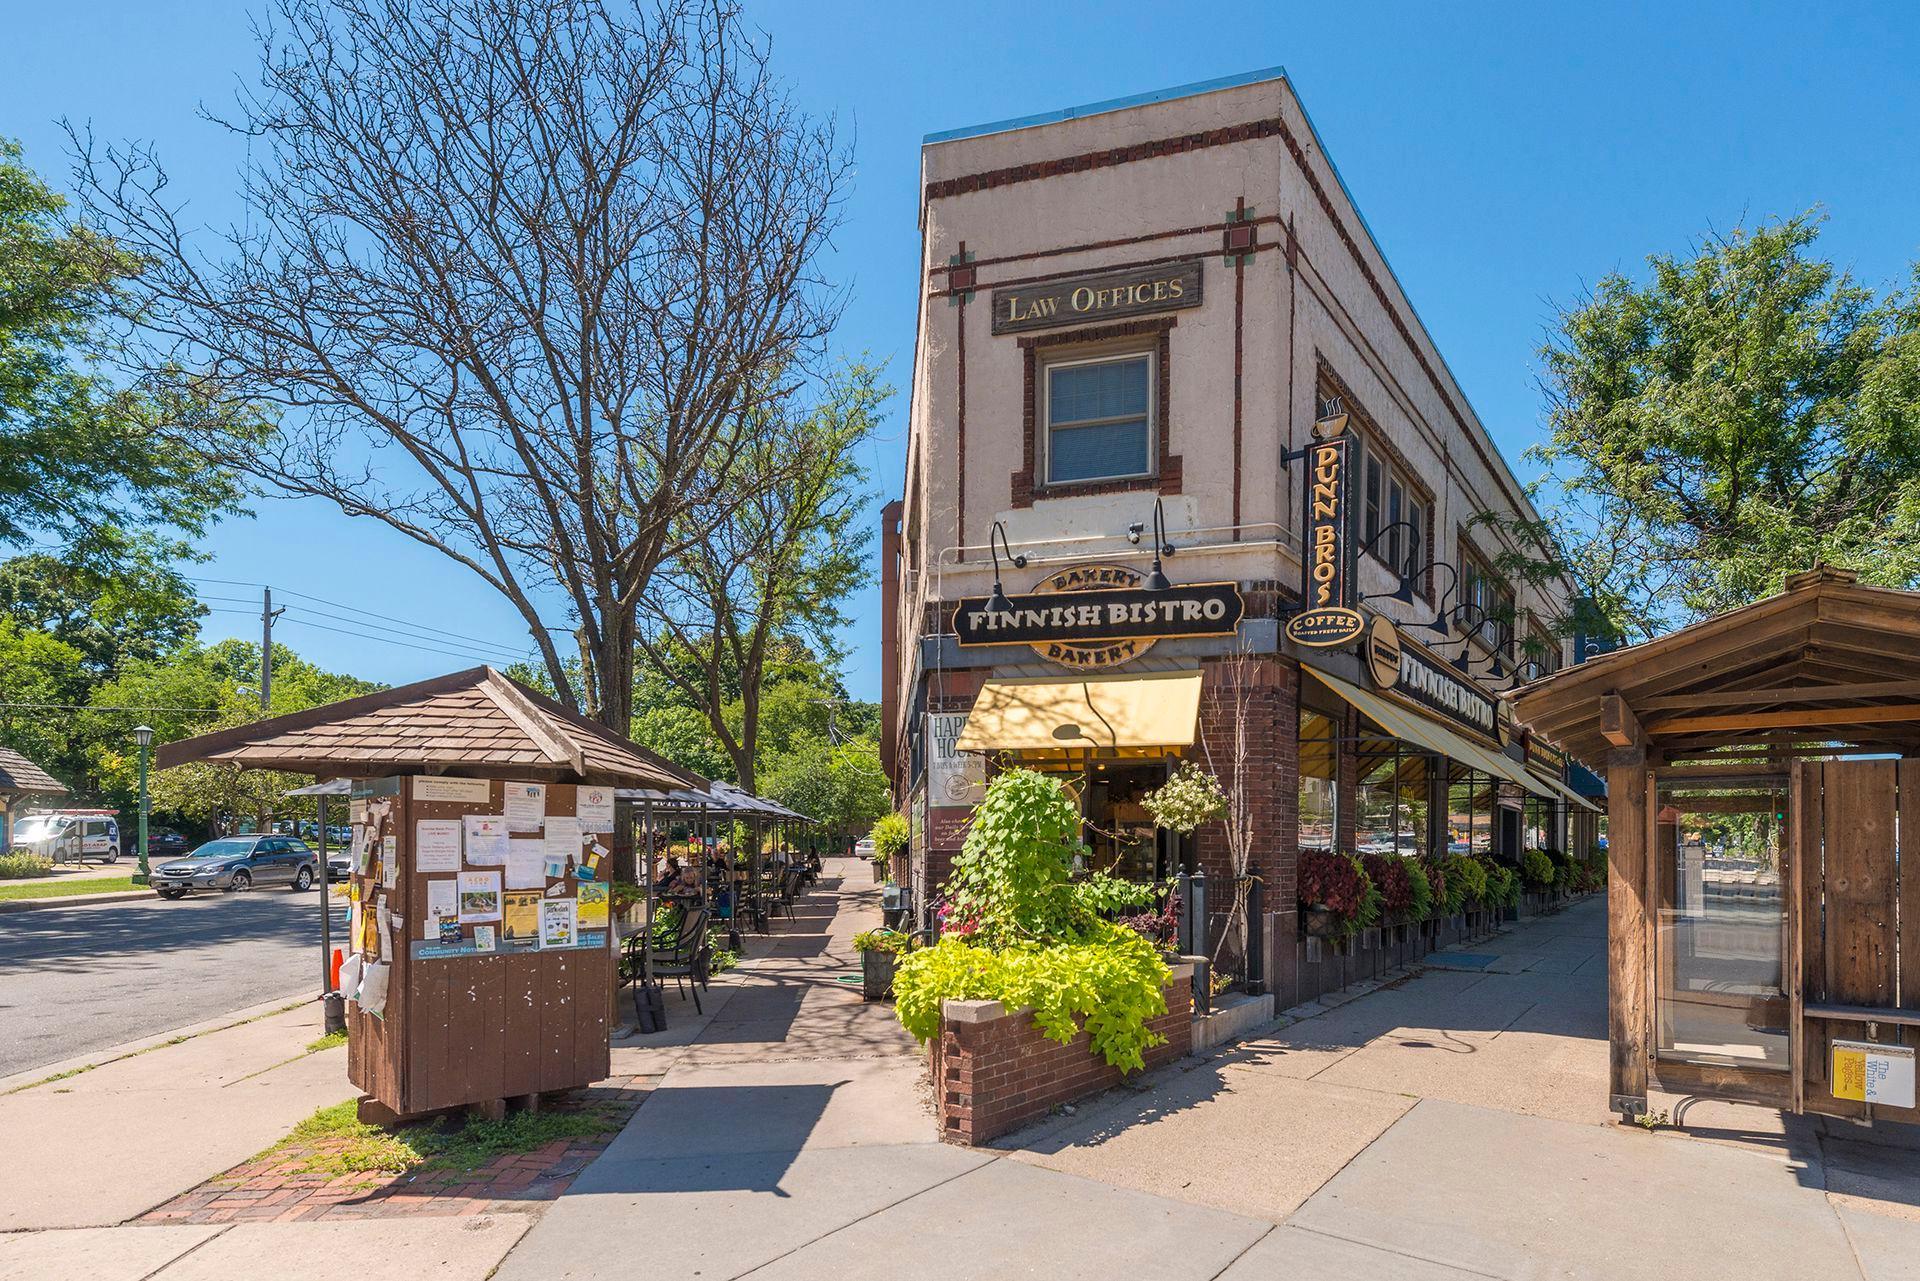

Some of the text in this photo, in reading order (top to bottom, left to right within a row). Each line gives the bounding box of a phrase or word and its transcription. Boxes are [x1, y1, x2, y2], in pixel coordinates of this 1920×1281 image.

[1008, 278, 1184, 322] LAW OFFICES
[1312, 447, 1339, 606] DUNN BROS
[1052, 568, 1142, 589] BAKERY
[967, 599, 1226, 631] FINNISH BISTRO
[1293, 615, 1357, 631] COFFEE
[1048, 640, 1137, 665] BAKERY
[1401, 651, 1494, 730] FINNISH BISTRO
[934, 716, 969, 738] HAP
[418, 947, 459, 956] COMMUNITY
[1842, 1057, 1854, 1085] Pages
[1854, 1059, 1866, 1090] Yellow
[1866, 1060, 1878, 1089] White
[1878, 1061, 1890, 1080] The
